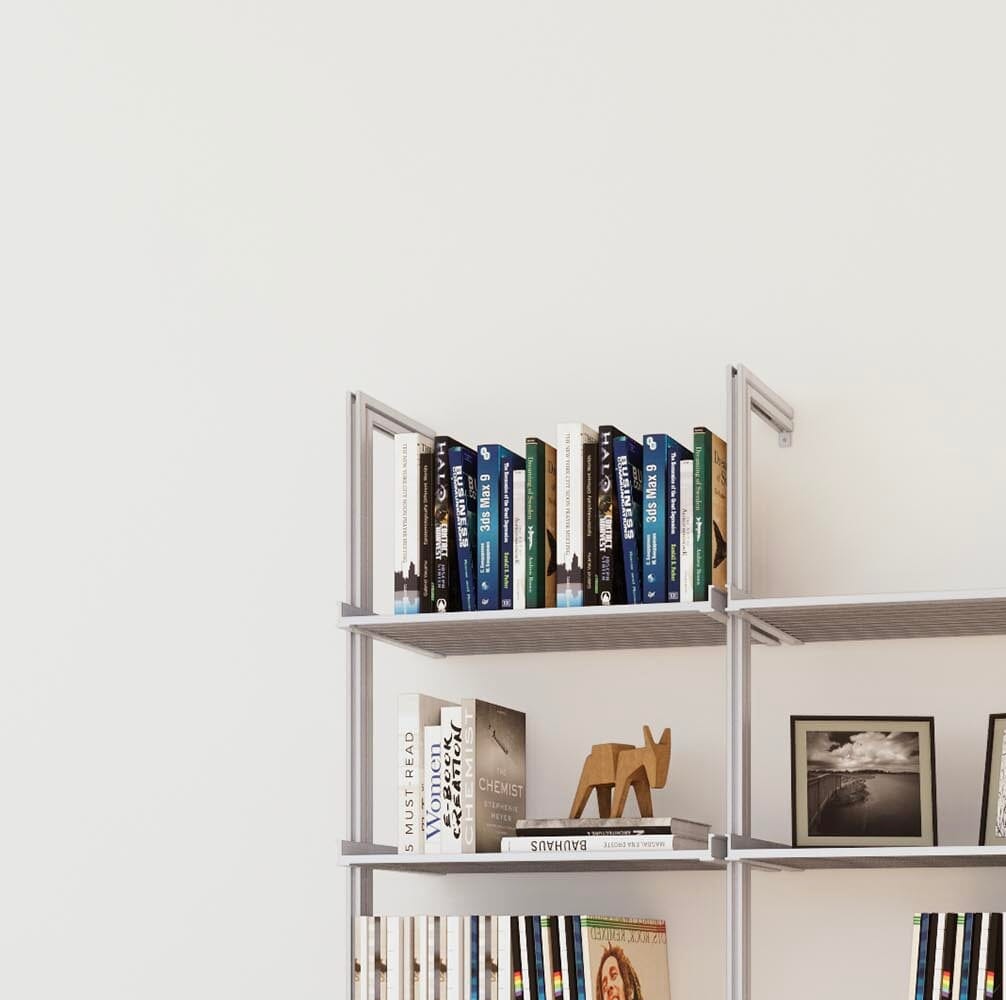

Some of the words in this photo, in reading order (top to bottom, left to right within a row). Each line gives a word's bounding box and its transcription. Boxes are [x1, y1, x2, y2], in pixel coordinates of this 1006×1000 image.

[436, 441, 446, 502] HALO
[601, 431, 611, 493] HALO
[646, 464, 657, 472] 9
[480, 484, 490, 508] Max
[620, 455, 634, 539] BUSINESS
[646, 474, 657, 499] Max
[454, 465, 469, 548] BUSINESS
[646, 503, 657, 523] 3ds
[480, 511, 490, 532] 3ds
[405, 731, 414, 835] MUST-READ
[443, 731, 453, 828] E-BOOK
[450, 720, 462, 839] CREATION
[464, 709, 474, 845] CHEMIST
[497, 767, 507, 777] THE
[426, 743, 442, 840] Women
[478, 777, 524, 799] CHEMIST
[491, 813, 513, 822] MEYER
[405, 844, 414, 852] 5
[530, 839, 587, 852] BAUHAUS
